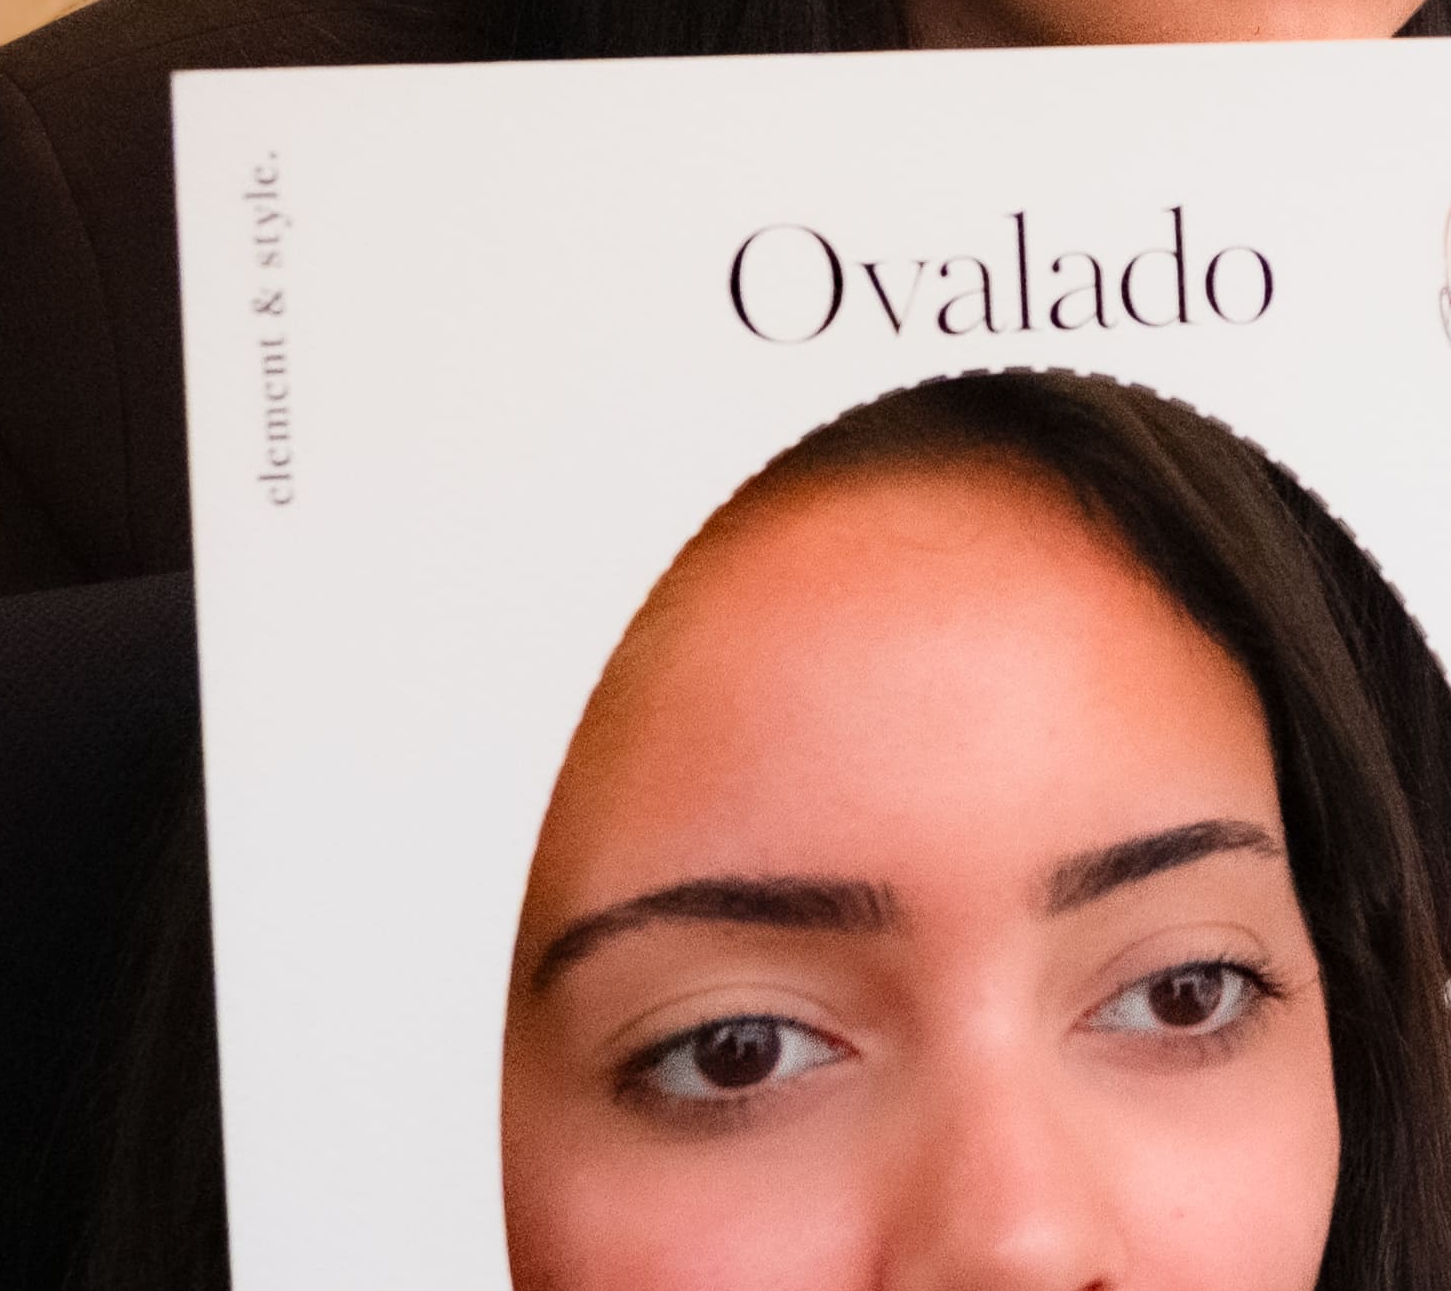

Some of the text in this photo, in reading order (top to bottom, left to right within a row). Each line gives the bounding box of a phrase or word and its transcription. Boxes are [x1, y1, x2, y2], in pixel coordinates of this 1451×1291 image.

[242, 150, 292, 266] style.
[727, 206, 1276, 346] Ovalado
[256, 336, 294, 508] element
